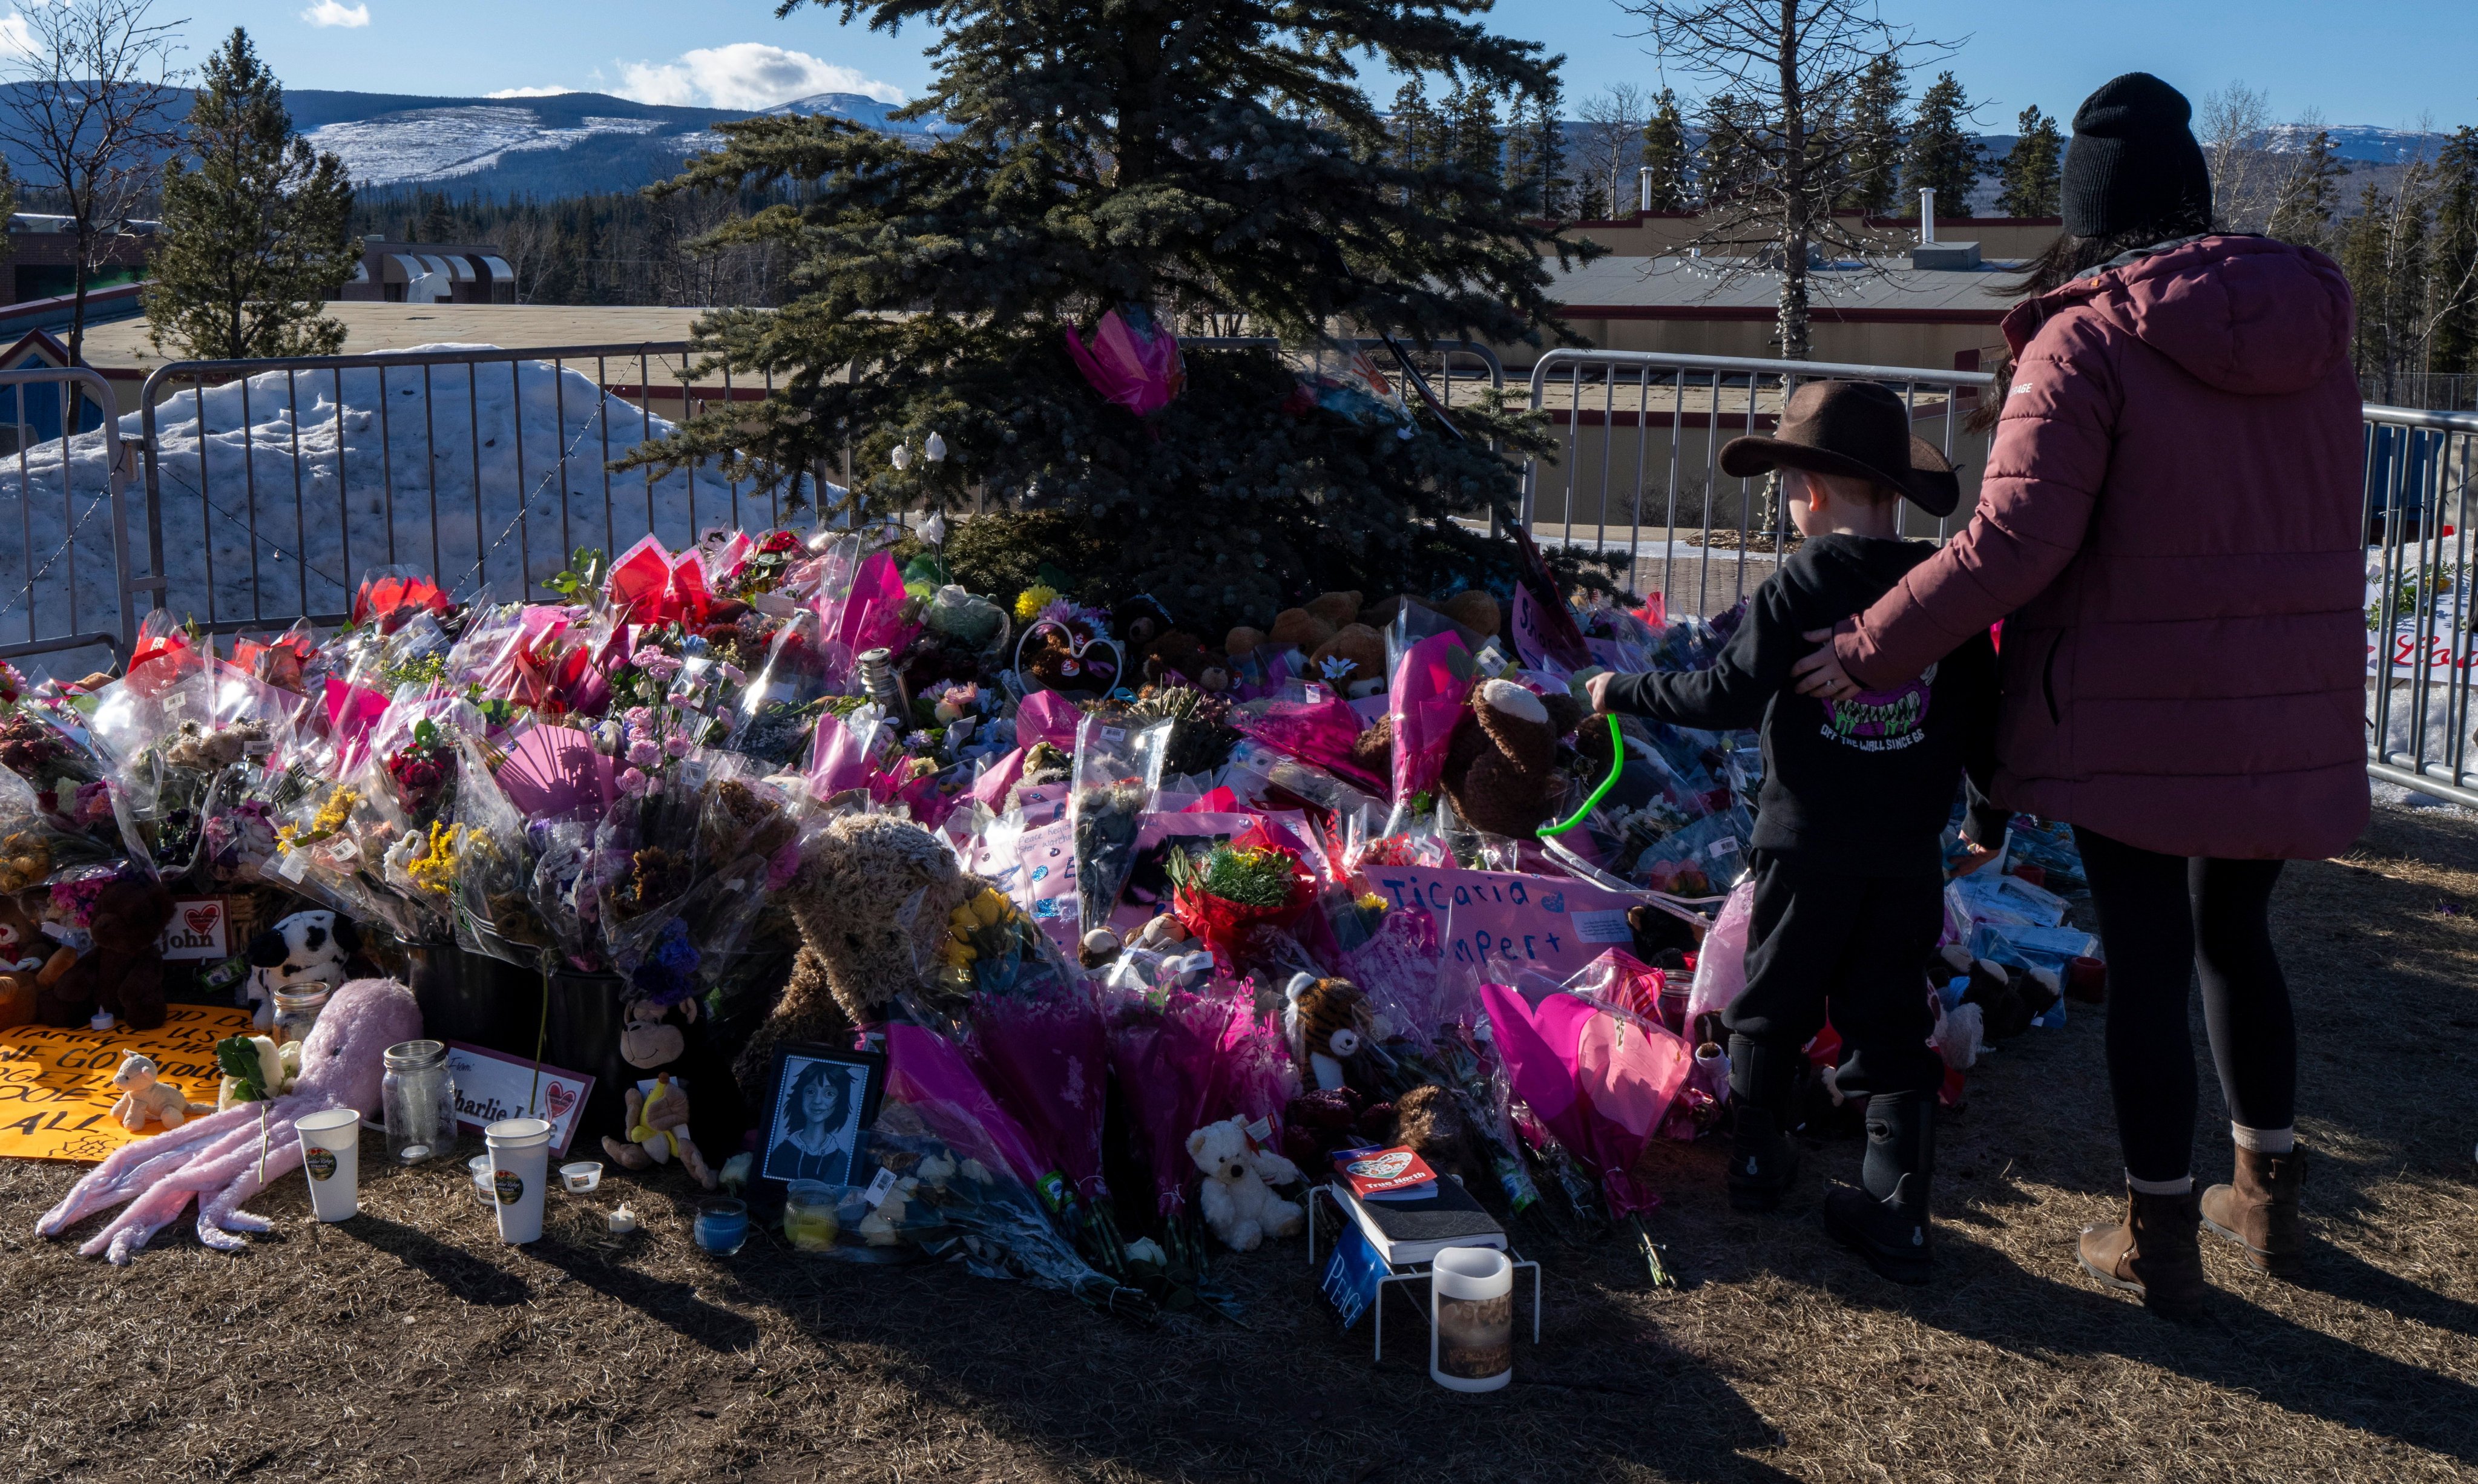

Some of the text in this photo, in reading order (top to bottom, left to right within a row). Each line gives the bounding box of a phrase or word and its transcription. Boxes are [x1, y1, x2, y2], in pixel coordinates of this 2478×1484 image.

[1820, 723, 1838, 741] OFF
[1840, 735, 1859, 748] THE
[1859, 740, 1885, 752] WALL
[1885, 735, 1913, 750] SINCE
[1017, 844, 1037, 854] Star
[1018, 833, 1043, 846] Peace
[56, 1048, 118, 1069] GO
[455, 1088, 507, 1122] harlie
[0, 1111, 107, 1135] ALL
[1365, 1181, 1393, 1189] True
[1393, 1172, 1427, 1185] North
[1321, 1252, 1363, 1328] PEACE
